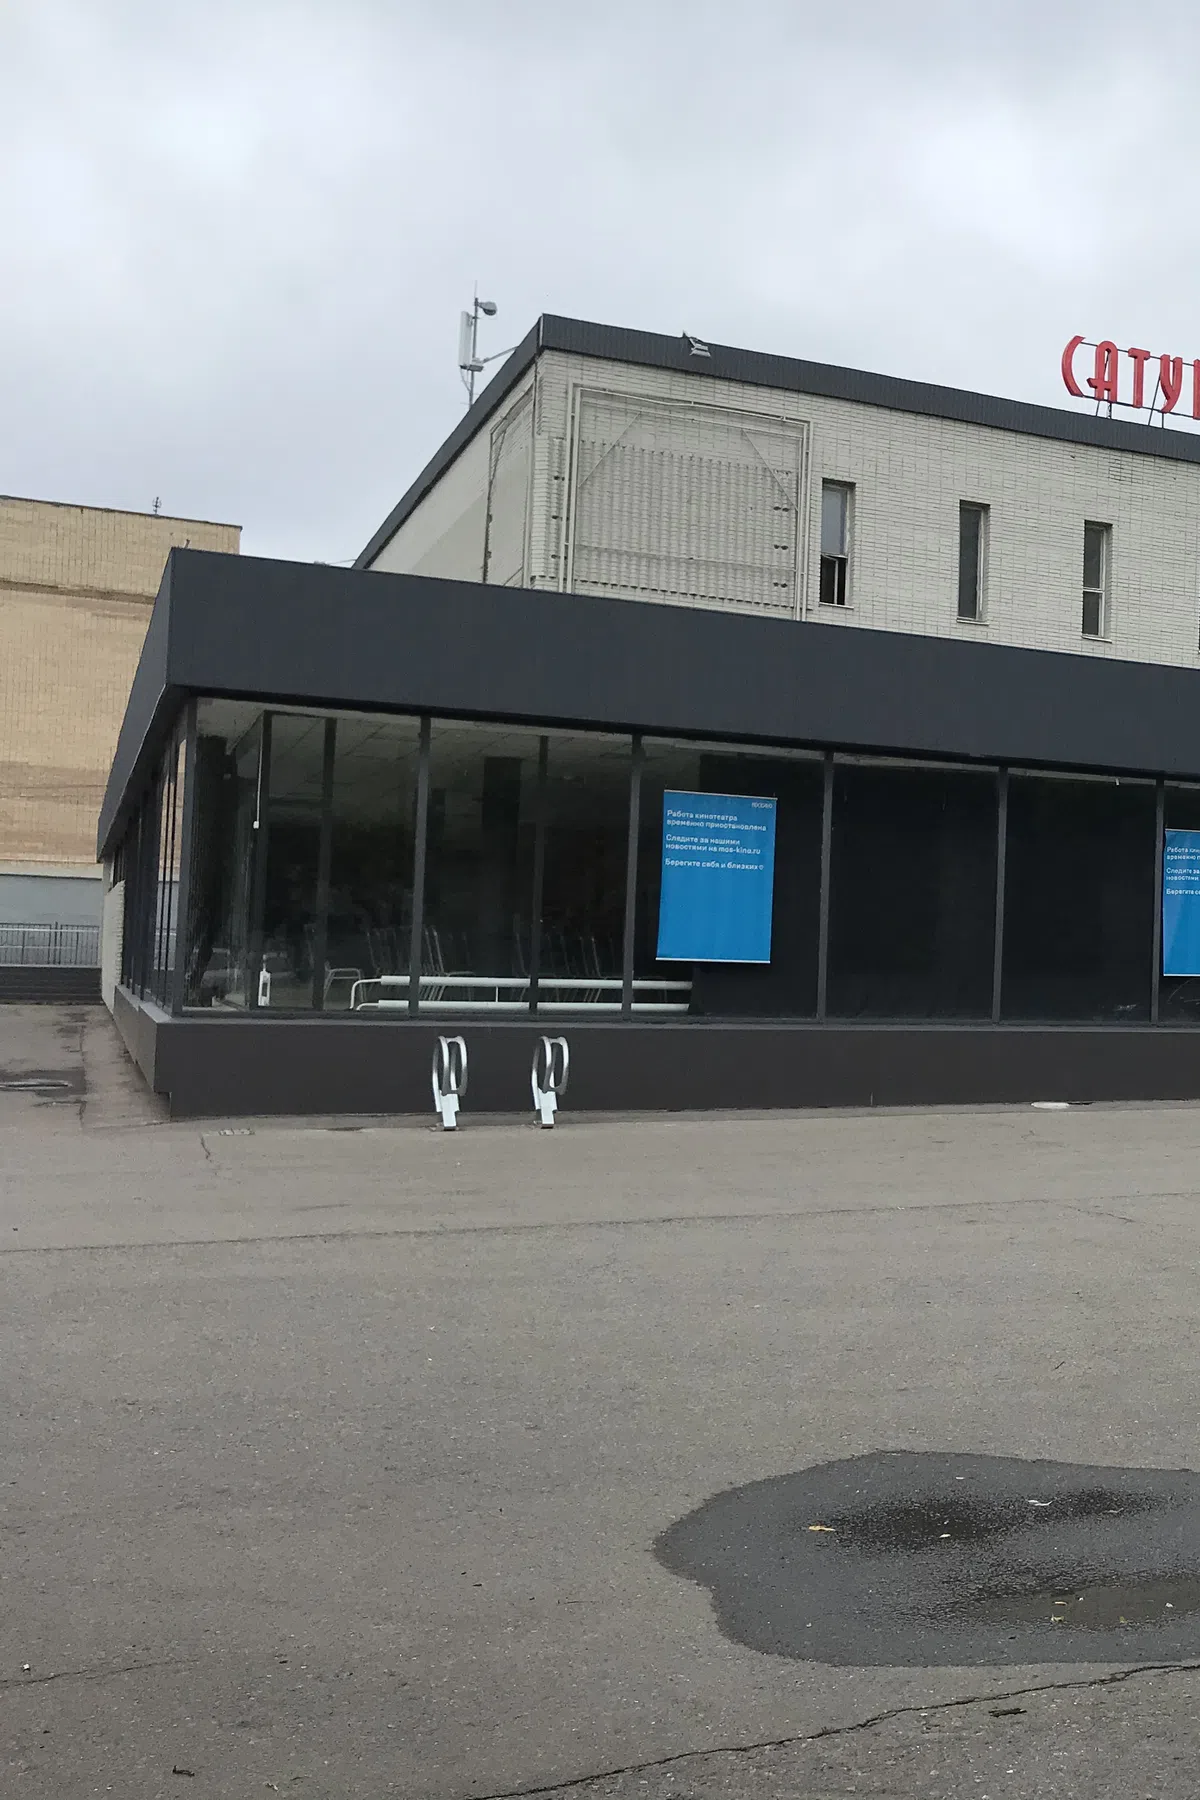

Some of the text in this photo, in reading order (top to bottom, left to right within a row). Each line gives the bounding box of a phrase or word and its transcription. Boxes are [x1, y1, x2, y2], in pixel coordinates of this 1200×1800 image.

[667, 809, 738, 822] Работа кинотеатра
[666, 819, 767, 832] временно приостановлена
[666, 834, 698, 843] Следите
[665, 843, 707, 851] новостями
[718, 846, 761, 855] mos-kino.ru
[665, 858, 700, 868] Берегите
[702, 860, 720, 868] себя
[727, 862, 758, 870] близких
